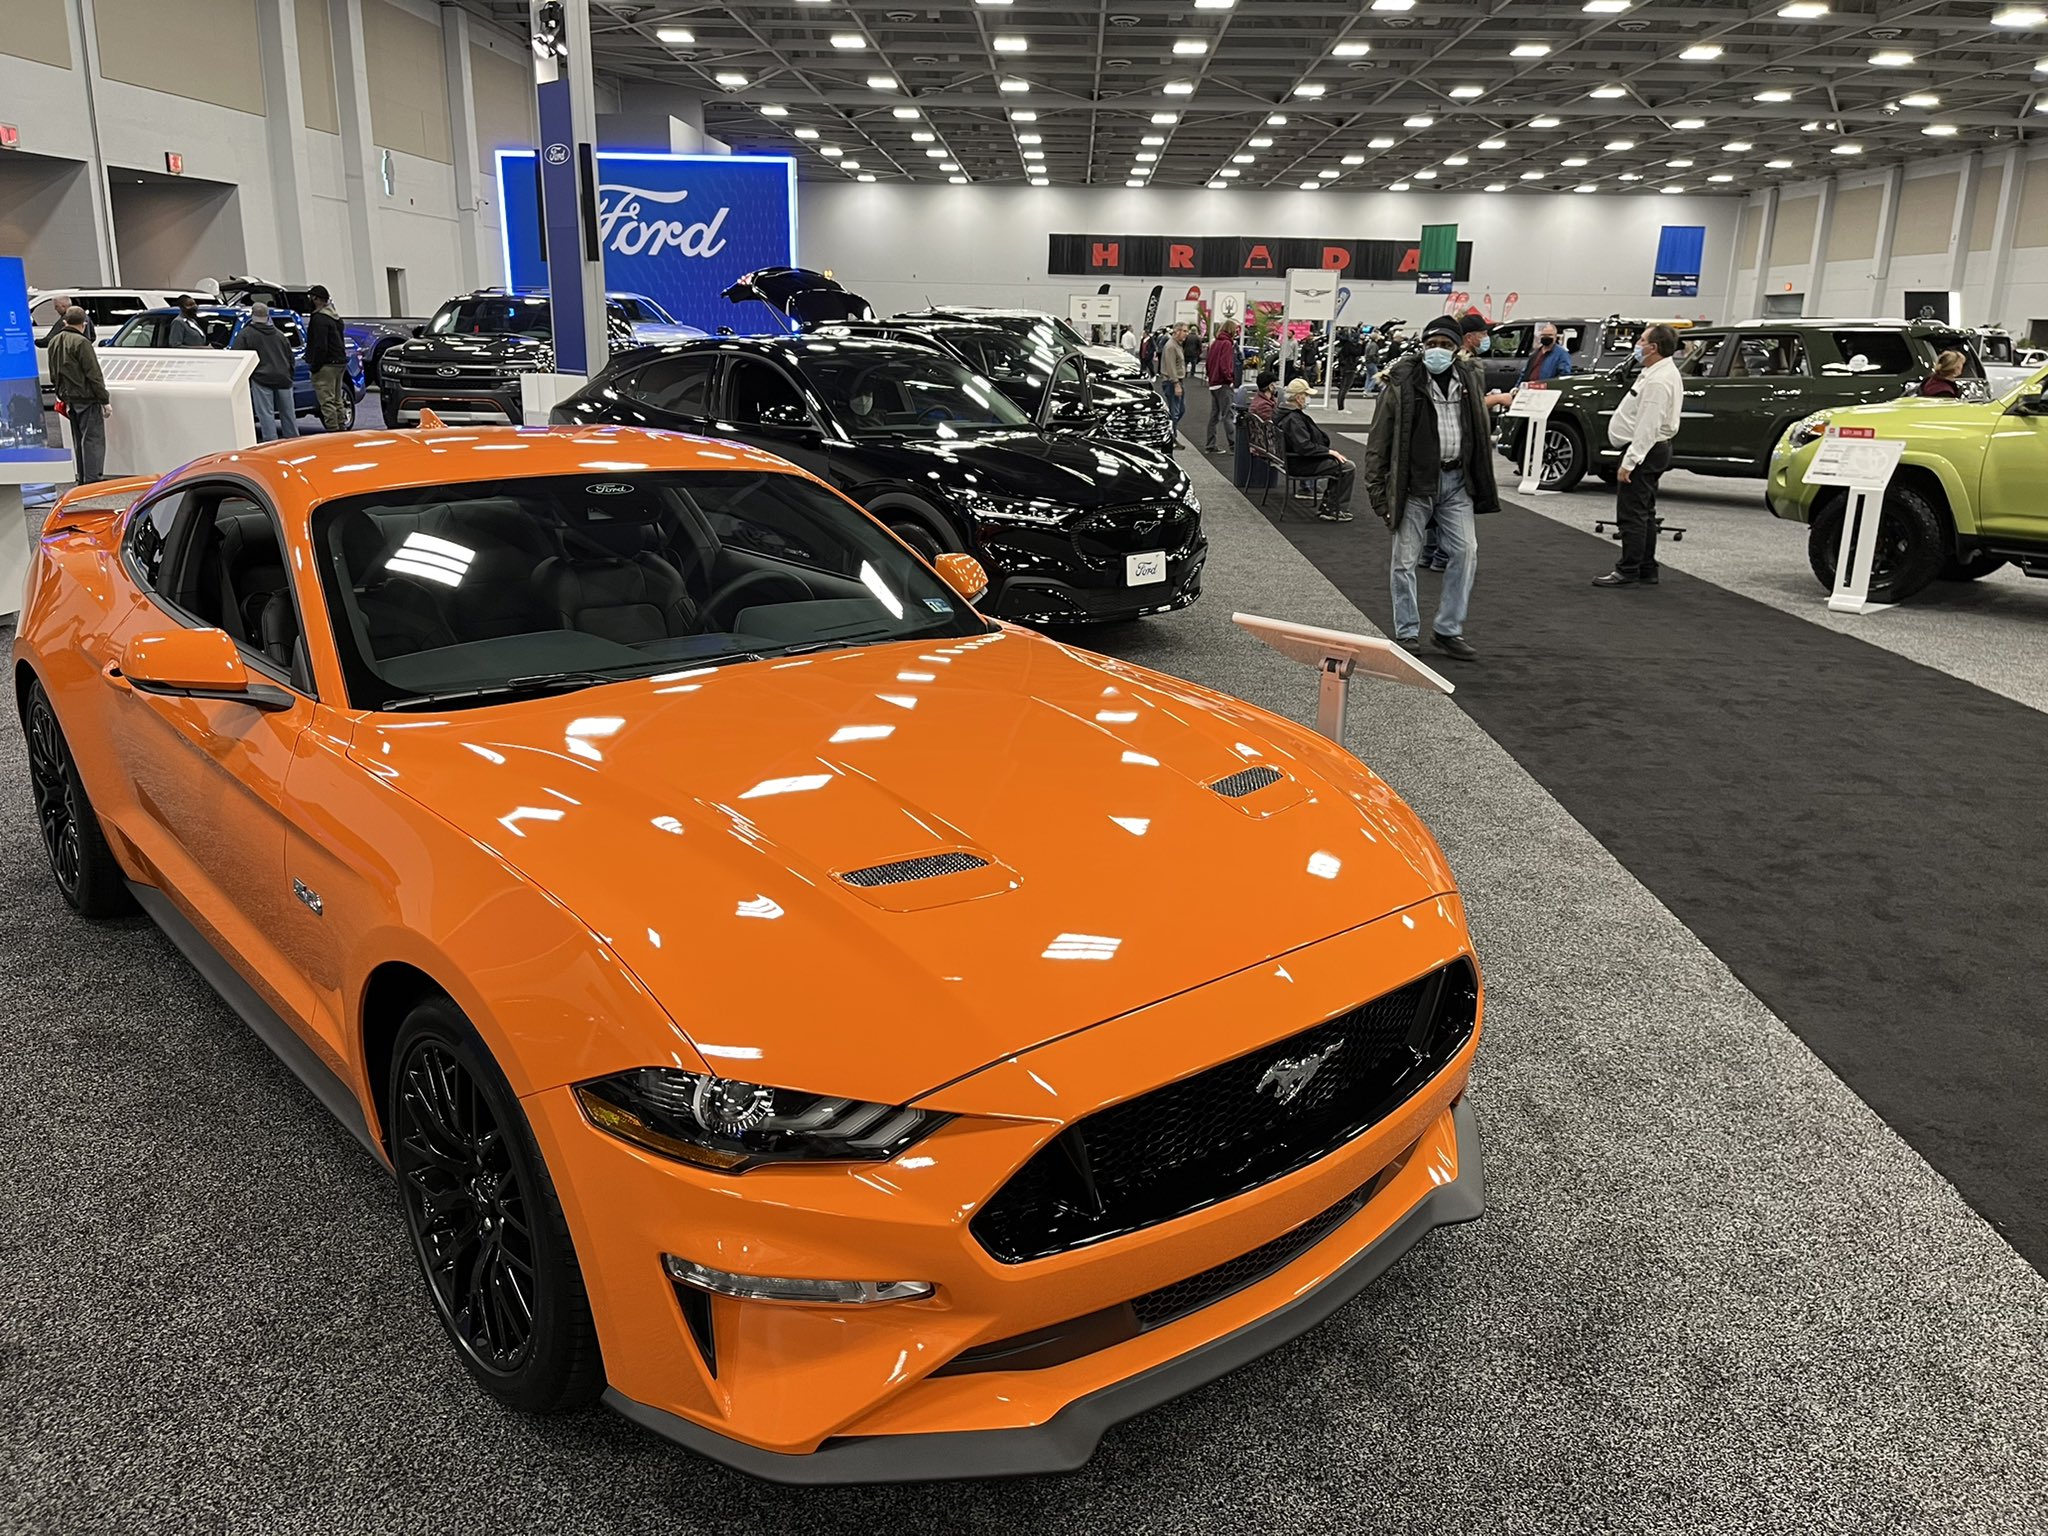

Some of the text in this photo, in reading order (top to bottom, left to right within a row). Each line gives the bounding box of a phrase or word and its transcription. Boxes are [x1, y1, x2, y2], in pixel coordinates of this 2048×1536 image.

[549, 146, 566, 162] Ford
[600, 184, 730, 258] Ford
[595, 484, 627, 494] Ford
[1135, 561, 1158, 577] Ford
